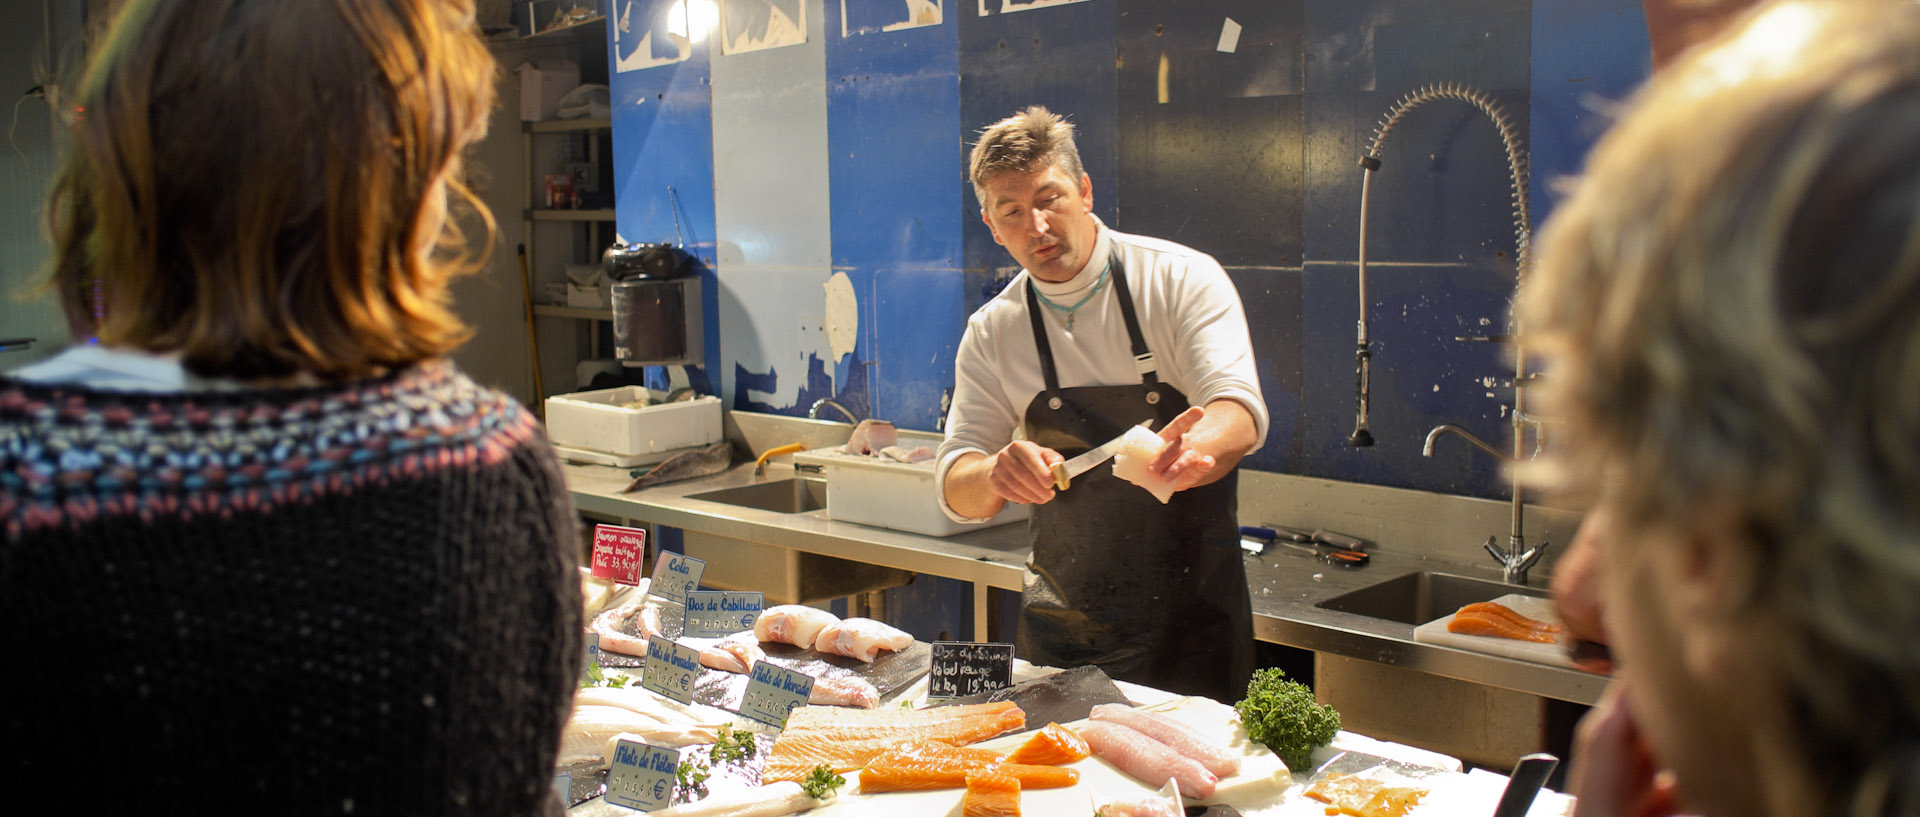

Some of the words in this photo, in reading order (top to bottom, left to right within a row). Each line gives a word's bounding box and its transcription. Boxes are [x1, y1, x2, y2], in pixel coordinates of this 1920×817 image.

[668, 558, 690, 575] Colin
[688, 597, 704, 611] Dos
[707, 597, 718, 611] de
[721, 597, 761, 611] Cabillaud
[649, 642, 663, 659] Filets
[663, 646, 671, 662] de
[671, 648, 696, 671] Grenadier
[752, 665, 772, 684] Filets
[772, 671, 783, 689] de
[782, 674, 809, 697] Dorade
[960, 664, 991, 682] rouge
[944, 677, 957, 697] kg
[616, 745, 638, 766] Filets
[638, 750, 649, 769] de
[650, 752, 676, 774] Flétan
